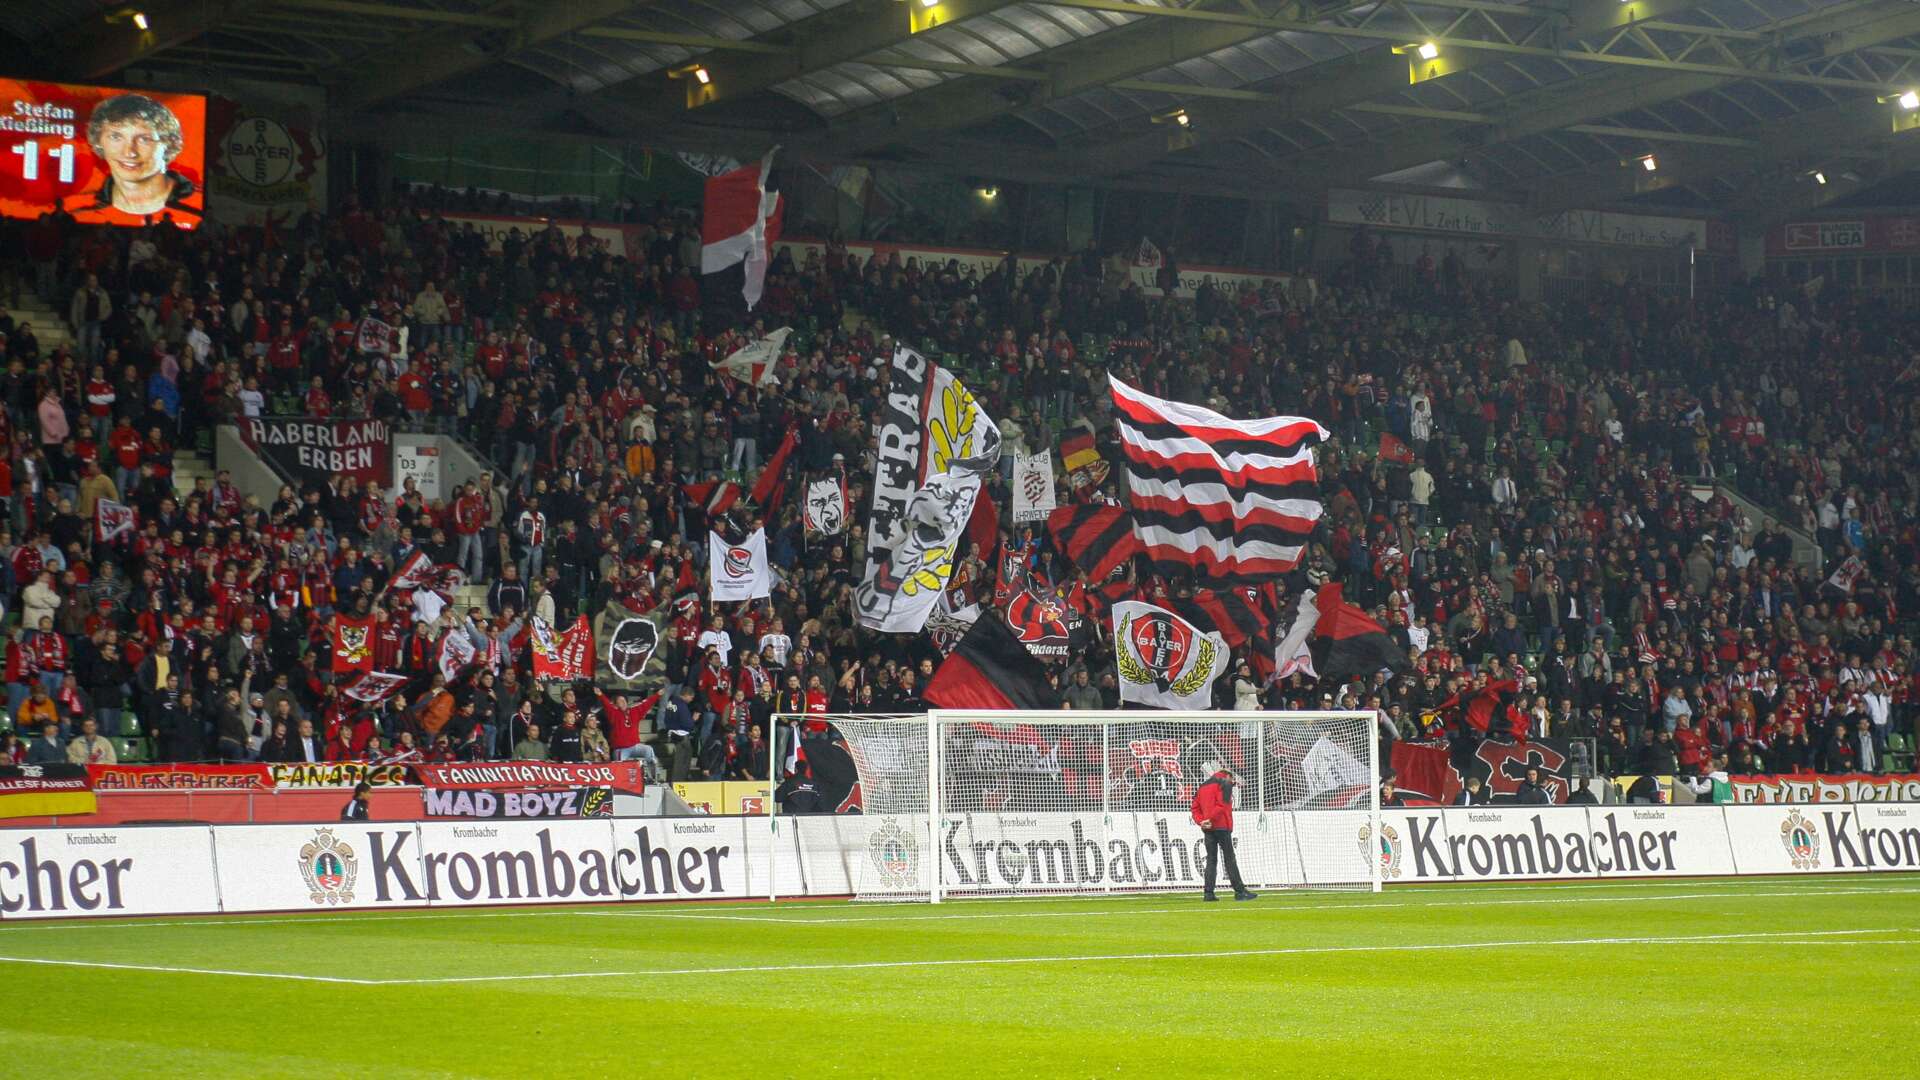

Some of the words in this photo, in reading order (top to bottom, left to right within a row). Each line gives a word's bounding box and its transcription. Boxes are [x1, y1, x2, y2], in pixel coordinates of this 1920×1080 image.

[13, 99, 75, 119] Stefan
[11, 140, 75, 183] 11
[299, 446, 373, 472] ERBEN
[401, 458, 416, 470] D3
[1139, 637, 1182, 652] BAYER
[437, 765, 575, 784] FANINITIATIVE
[425, 788, 497, 817] MAD
[504, 791, 578, 817] BOYZ
[1468, 812, 1502, 823] Krombacher
[1633, 809, 1665, 819] Krombacher
[453, 825, 498, 838] Krombacher
[673, 822, 716, 834] Krombacher
[67, 832, 118, 846] Krombacher
[1406, 812, 1677, 877] Krombacher
[366, 826, 730, 902] Krombacher
